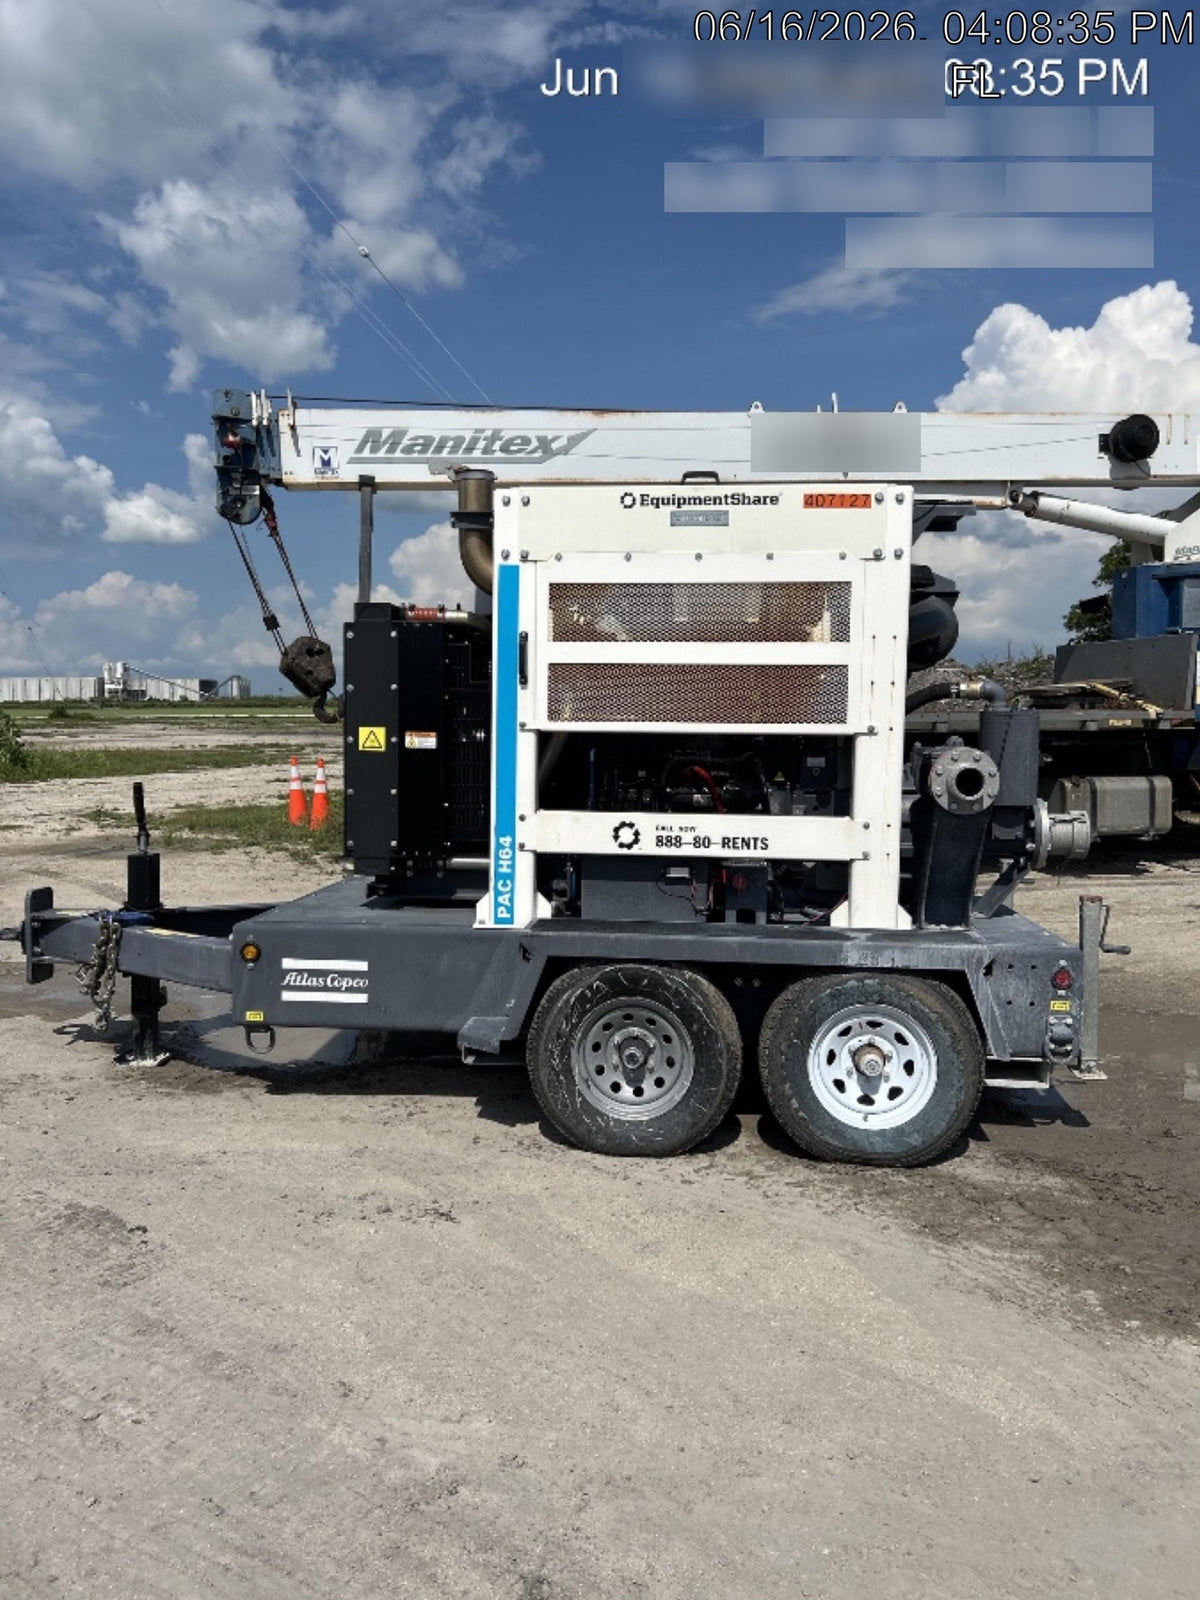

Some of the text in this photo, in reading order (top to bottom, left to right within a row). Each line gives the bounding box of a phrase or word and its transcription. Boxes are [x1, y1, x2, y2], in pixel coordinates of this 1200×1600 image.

[353, 427, 562, 456] Manitex
[639, 492, 780, 509] EquipmentShare
[804, 494, 871, 507] 407127
[655, 835, 769, 850] 888-80-RENTS
[497, 835, 513, 918] PAC H64
[281, 972, 369, 990] Atlas Copco
